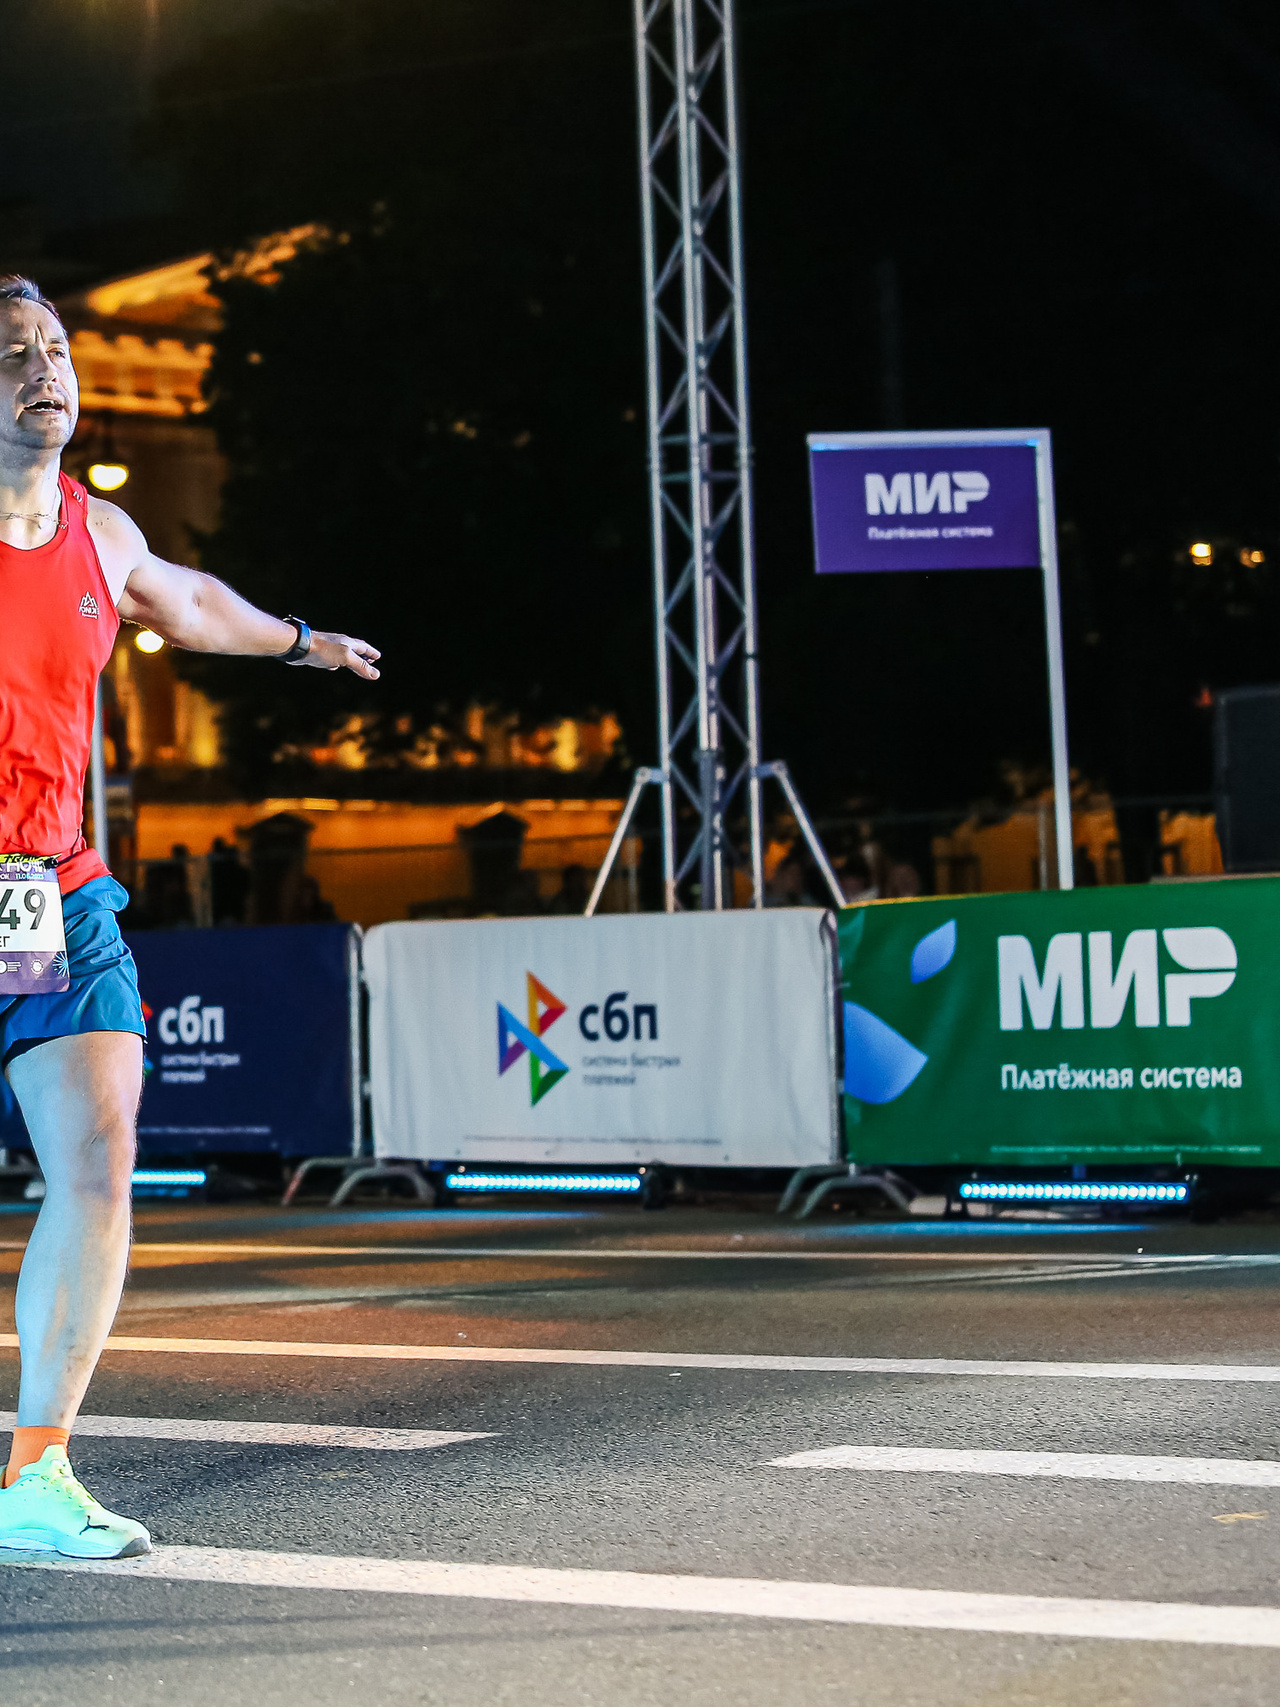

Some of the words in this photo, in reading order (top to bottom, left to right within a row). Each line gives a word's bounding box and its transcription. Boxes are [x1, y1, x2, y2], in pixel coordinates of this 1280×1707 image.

[864, 471, 989, 515] МИР
[996, 926, 1238, 1032] МИР
[1000, 1062, 1134, 1090] Платёжная
[1140, 1066, 1243, 1089] система
